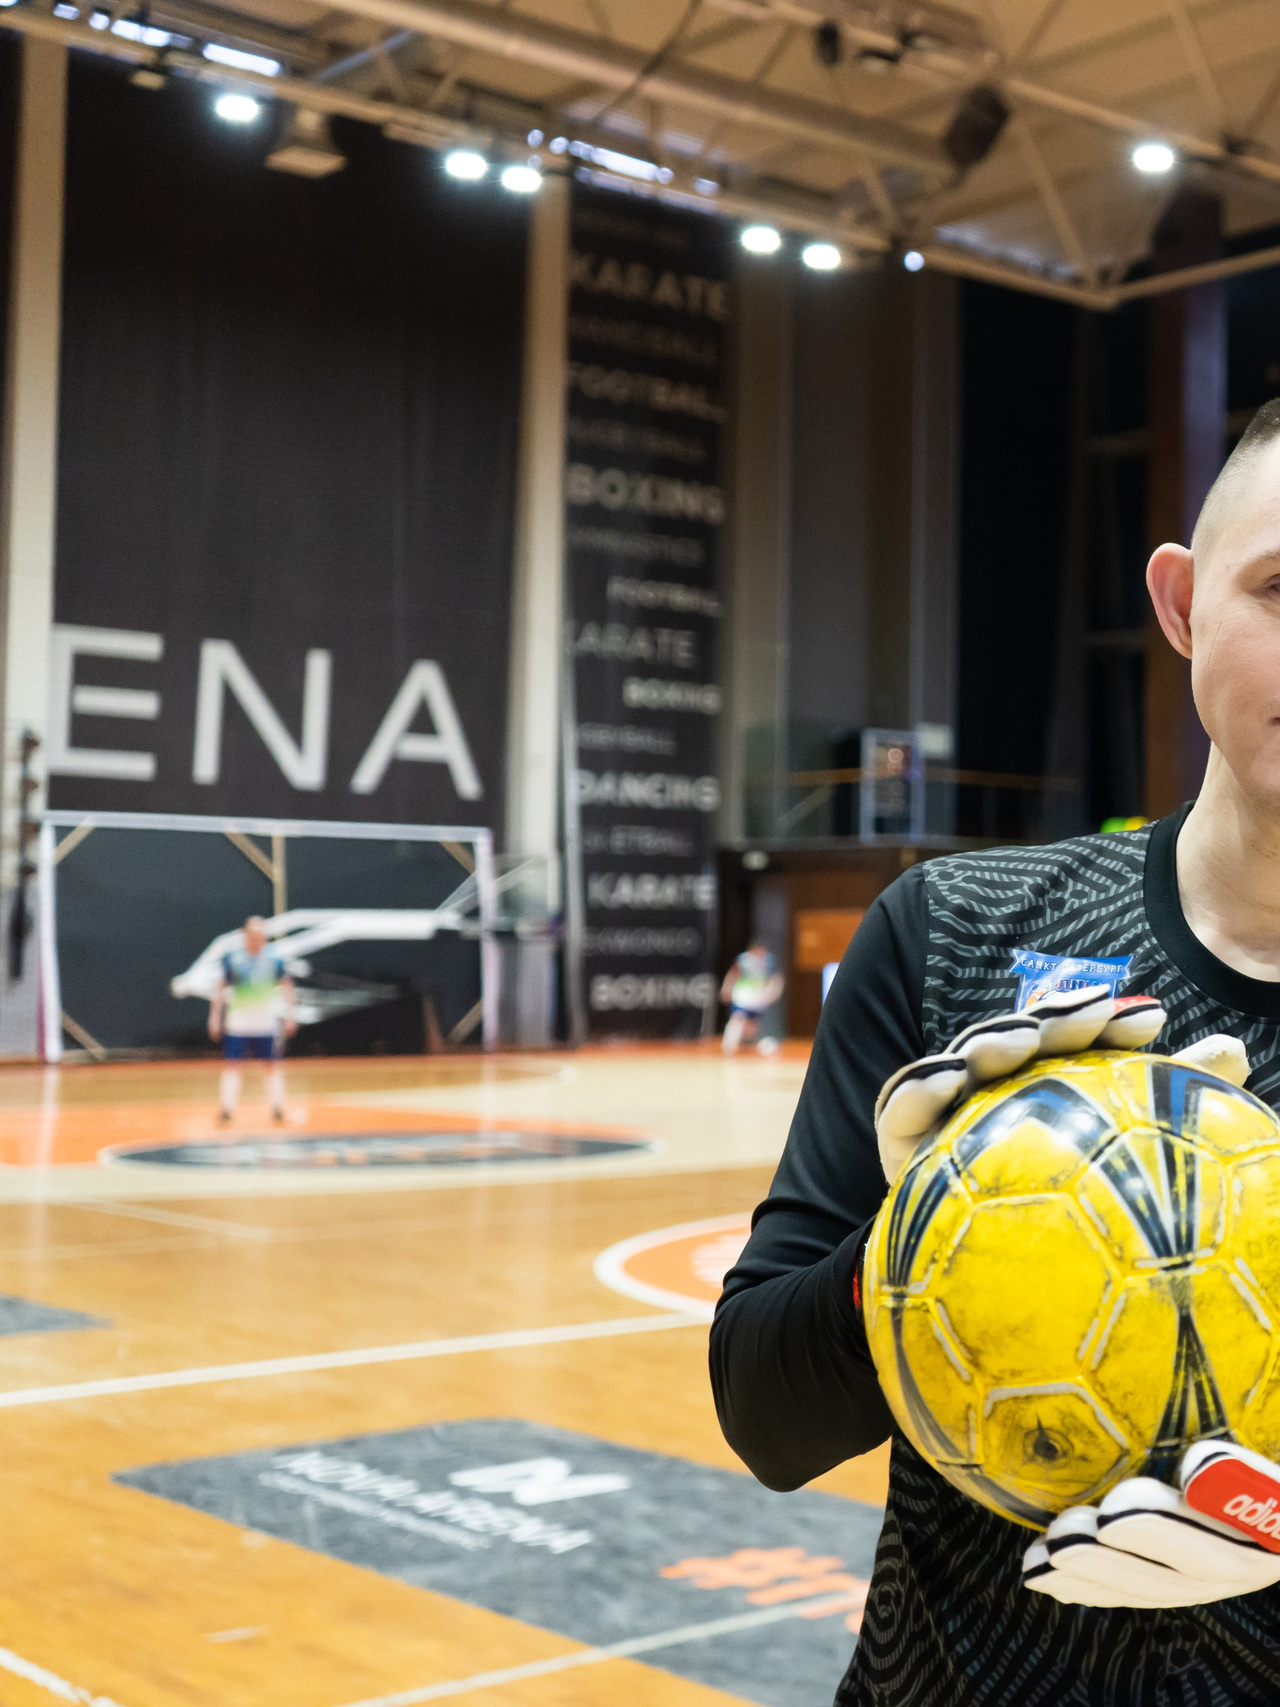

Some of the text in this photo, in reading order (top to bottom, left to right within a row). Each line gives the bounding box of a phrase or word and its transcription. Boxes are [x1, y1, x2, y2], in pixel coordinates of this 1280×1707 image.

[567, 252, 730, 323] KARATE
[565, 462, 727, 525] BOXING
[572, 620, 697, 669] ARATE
[48, 624, 484, 801] ENA
[622, 676, 722, 716] BOXING
[577, 768, 720, 813] DANCING
[587, 872, 718, 911] KARATE
[590, 973, 719, 1011] BOXING
